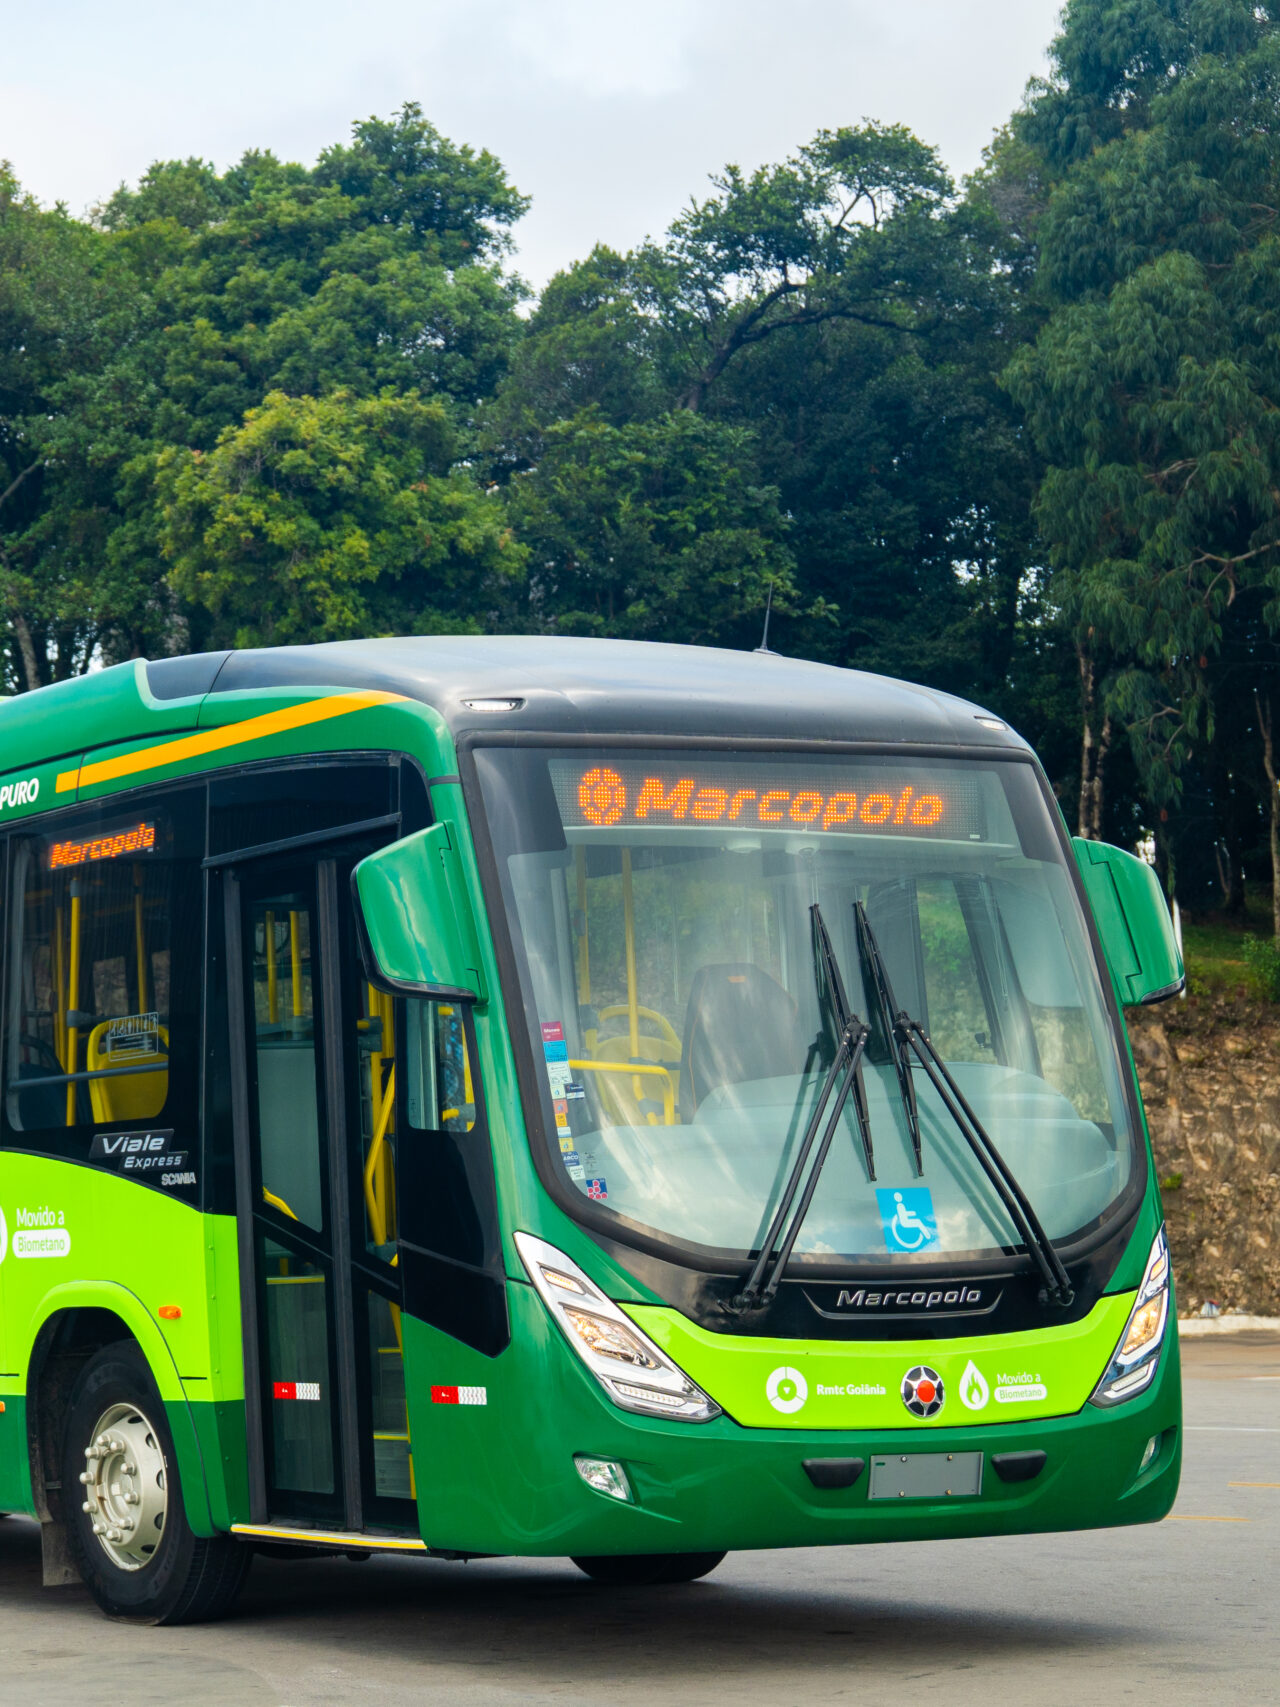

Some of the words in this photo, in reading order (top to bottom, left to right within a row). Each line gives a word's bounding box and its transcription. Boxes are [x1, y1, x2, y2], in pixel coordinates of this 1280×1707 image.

[635, 778, 943, 831] Marcopolo
[50, 823, 155, 869] Marcopolo
[102, 1134, 165, 1154] Viale
[124, 1155, 182, 1170] Express
[161, 1172, 196, 1186] SCANIA
[16, 1205, 55, 1227] Movido
[58, 1210, 65, 1226] a
[17, 1236, 65, 1252] Biometano
[837, 1286, 982, 1308] Marcopolo
[997, 1372, 1033, 1386] Movido
[1035, 1374, 1041, 1383] a
[817, 1384, 845, 1396] Rmtc
[848, 1383, 886, 1396] Goiânia
[999, 1387, 1042, 1400] Biometano
